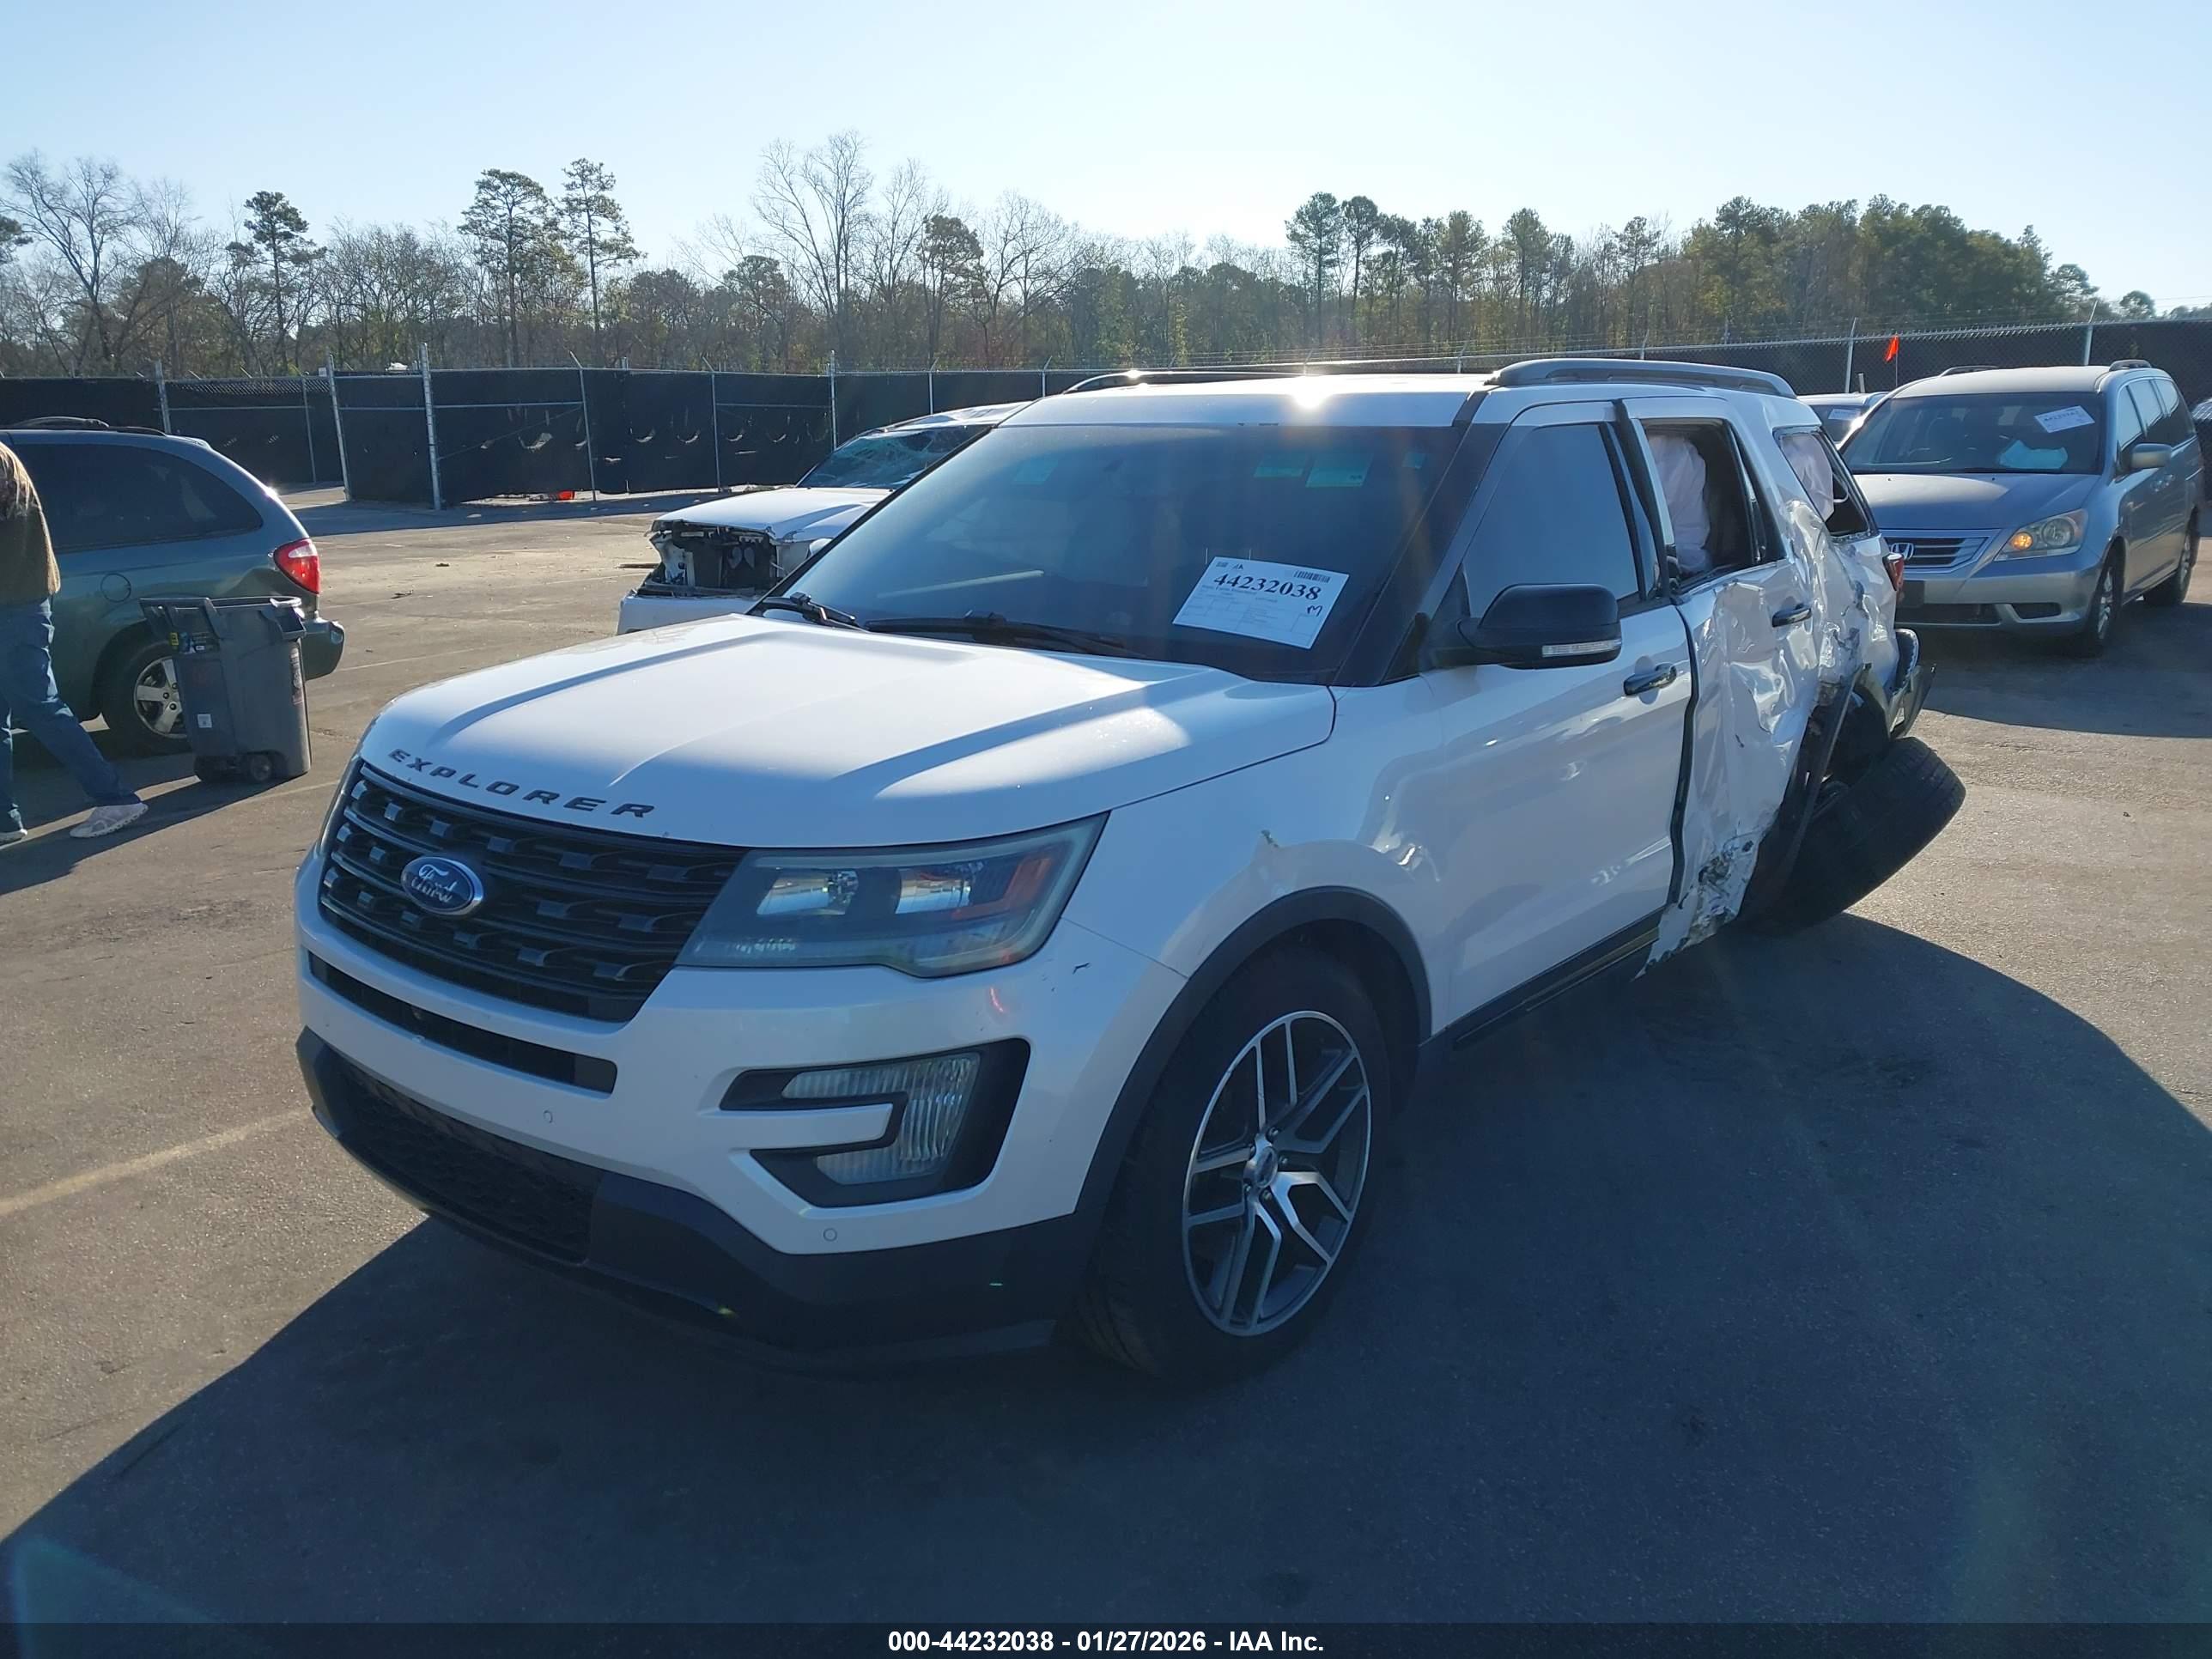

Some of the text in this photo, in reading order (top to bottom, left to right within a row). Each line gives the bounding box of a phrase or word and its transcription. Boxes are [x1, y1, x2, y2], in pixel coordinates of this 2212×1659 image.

[1214, 574, 1322, 599] 44232038
[389, 749, 655, 817] EXPLORER
[410, 864, 458, 902] Ford
